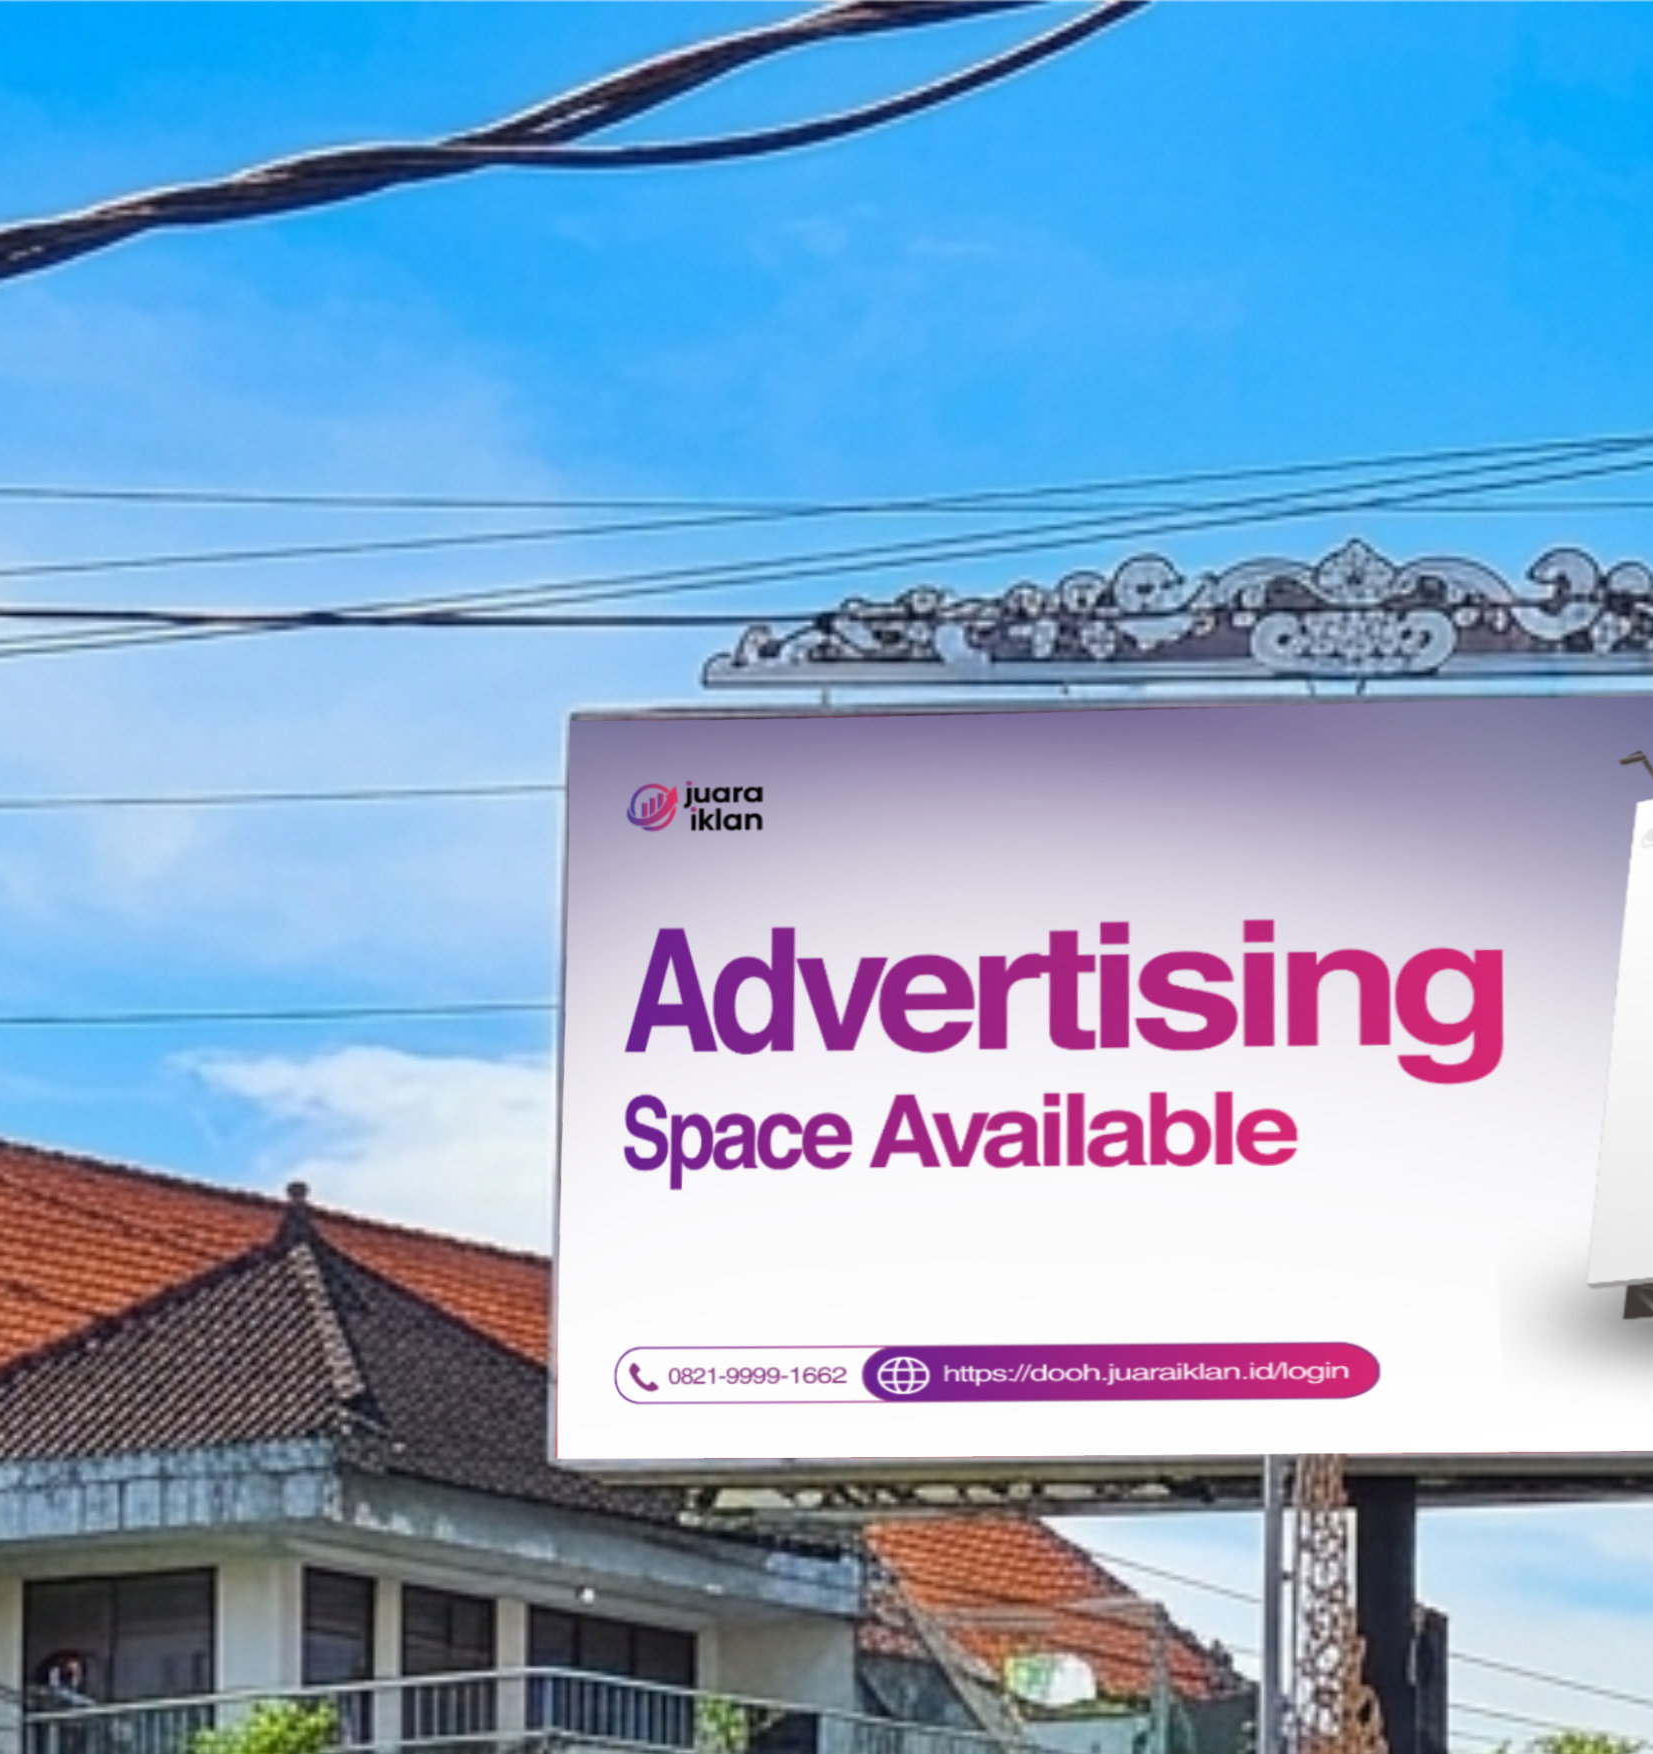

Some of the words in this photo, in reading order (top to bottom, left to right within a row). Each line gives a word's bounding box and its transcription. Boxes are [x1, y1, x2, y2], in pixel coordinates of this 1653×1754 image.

[684, 780, 763, 809] juara
[691, 806, 763, 831] iklan
[625, 919, 1503, 1084] Advertising
[624, 1094, 852, 1190] Space
[869, 1091, 1299, 1169] Available
[668, 1367, 848, 1385] 0821-9999-1662
[943, 1362, 1350, 1387] https://dooh.juaraiklan.id/login
